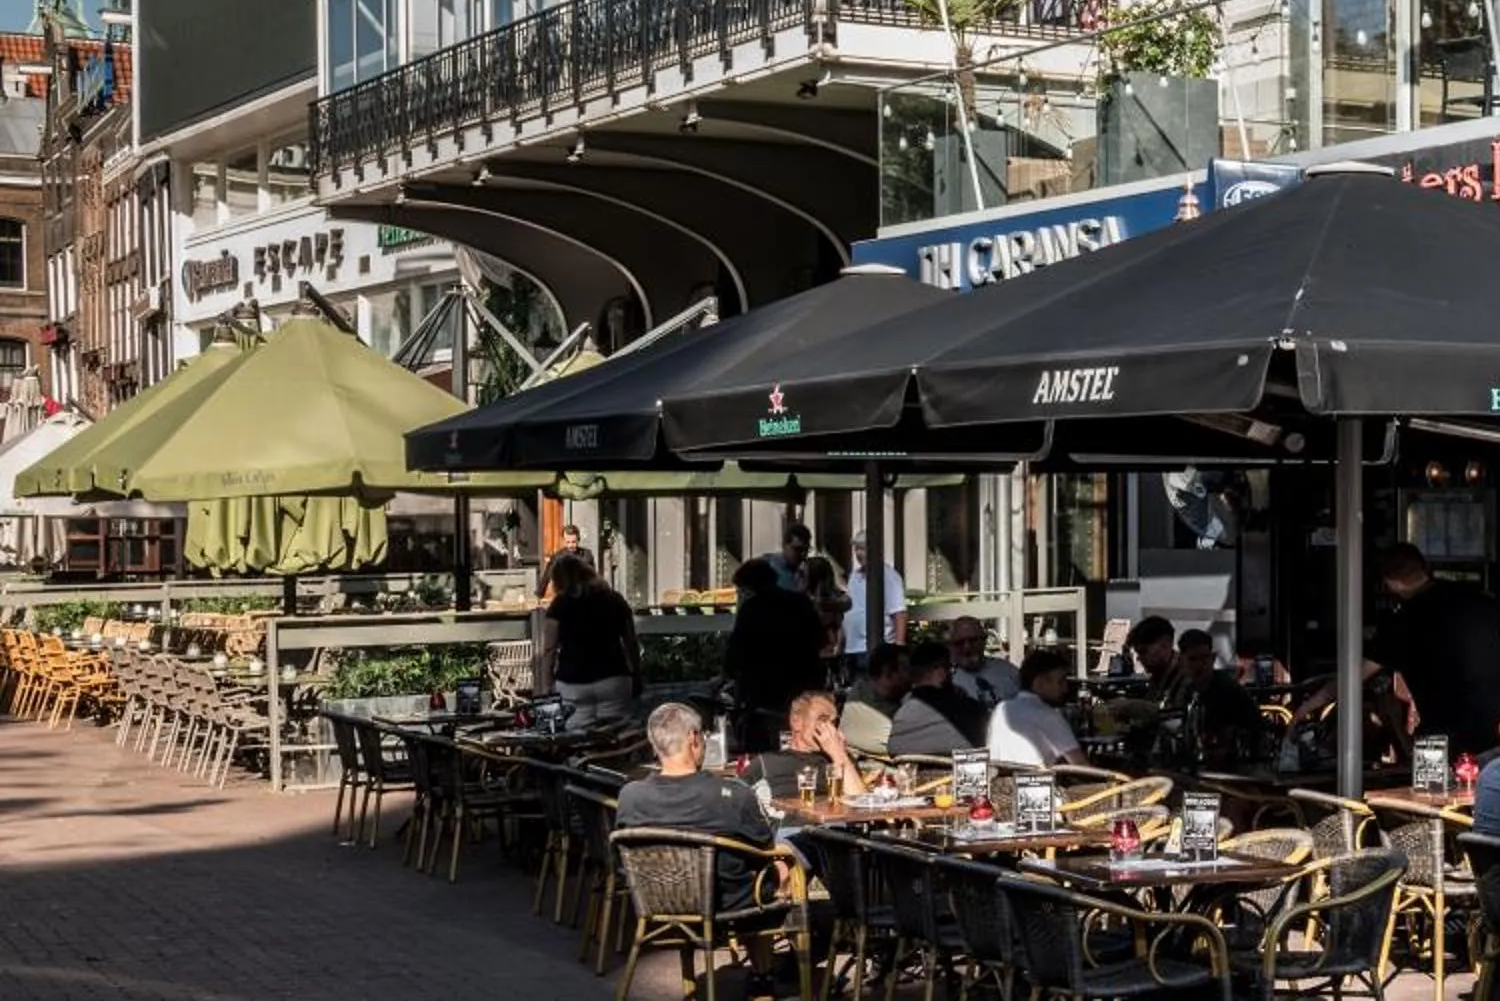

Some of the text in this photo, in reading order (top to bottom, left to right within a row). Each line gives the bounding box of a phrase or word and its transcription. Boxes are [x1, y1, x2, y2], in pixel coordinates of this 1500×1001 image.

[967, 215, 1128, 287] CARANSA
[1033, 366, 1119, 405] AMSTEL
[758, 416, 801, 437] Heineken
